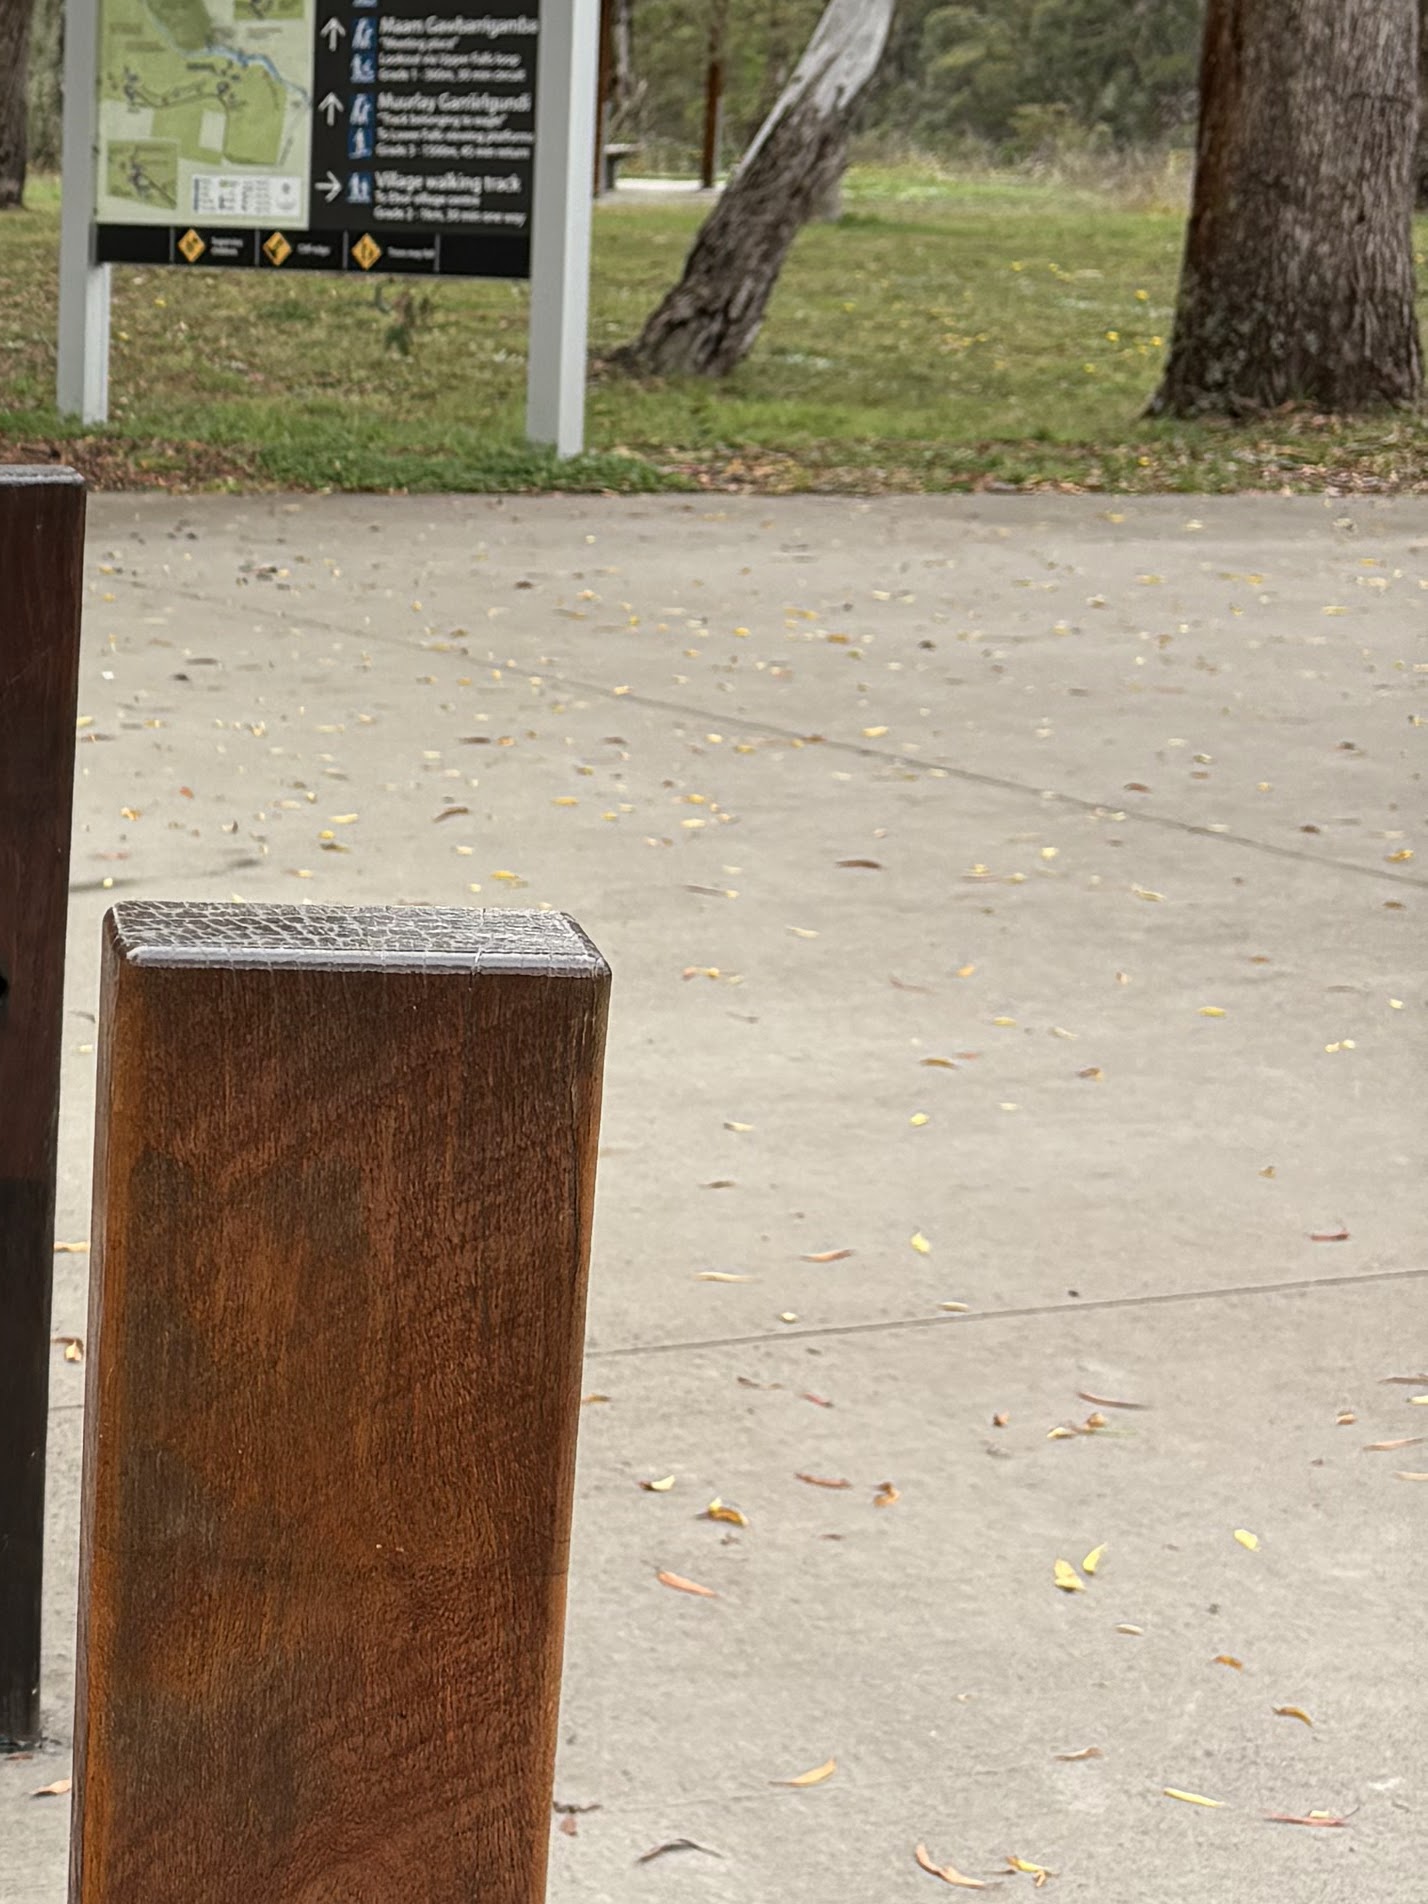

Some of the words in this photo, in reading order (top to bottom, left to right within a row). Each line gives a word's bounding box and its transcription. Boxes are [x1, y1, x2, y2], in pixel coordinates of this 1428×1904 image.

[374, 170, 424, 193] Village
[425, 171, 482, 196] walking
[483, 173, 522, 193] track
